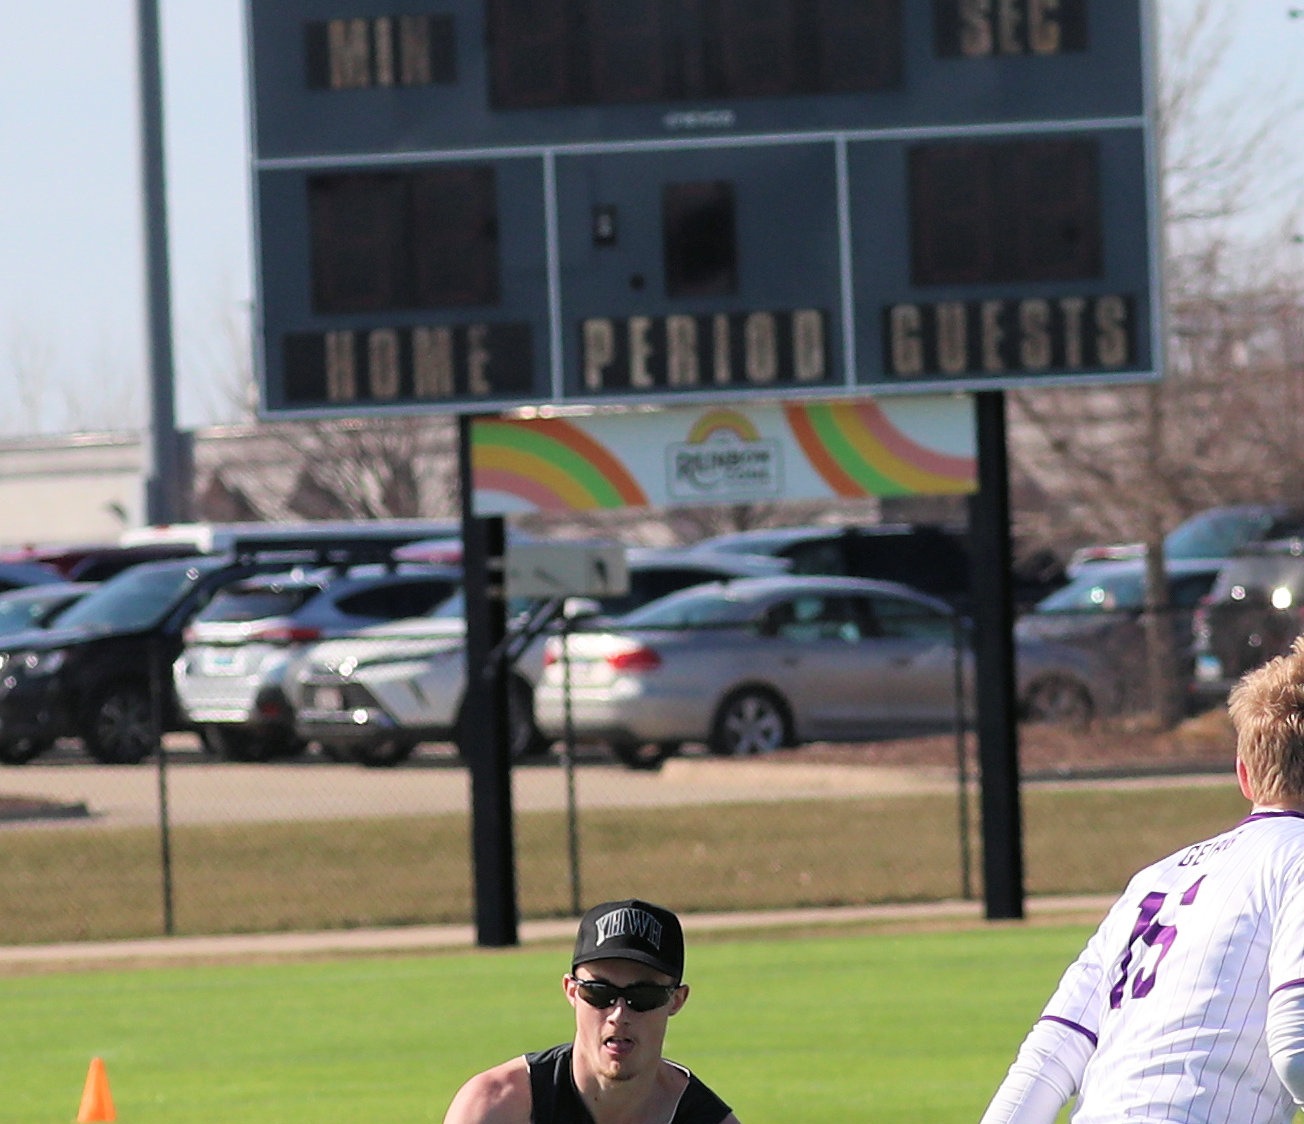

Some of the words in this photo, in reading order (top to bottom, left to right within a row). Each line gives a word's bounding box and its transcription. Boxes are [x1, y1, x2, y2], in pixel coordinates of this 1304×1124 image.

[328, 18, 432, 89] MIN
[960, 0, 1061, 57] SEC
[325, 322, 490, 400] HOME
[584, 307, 826, 389] PERIOD
[890, 295, 1129, 376] GUESTS
